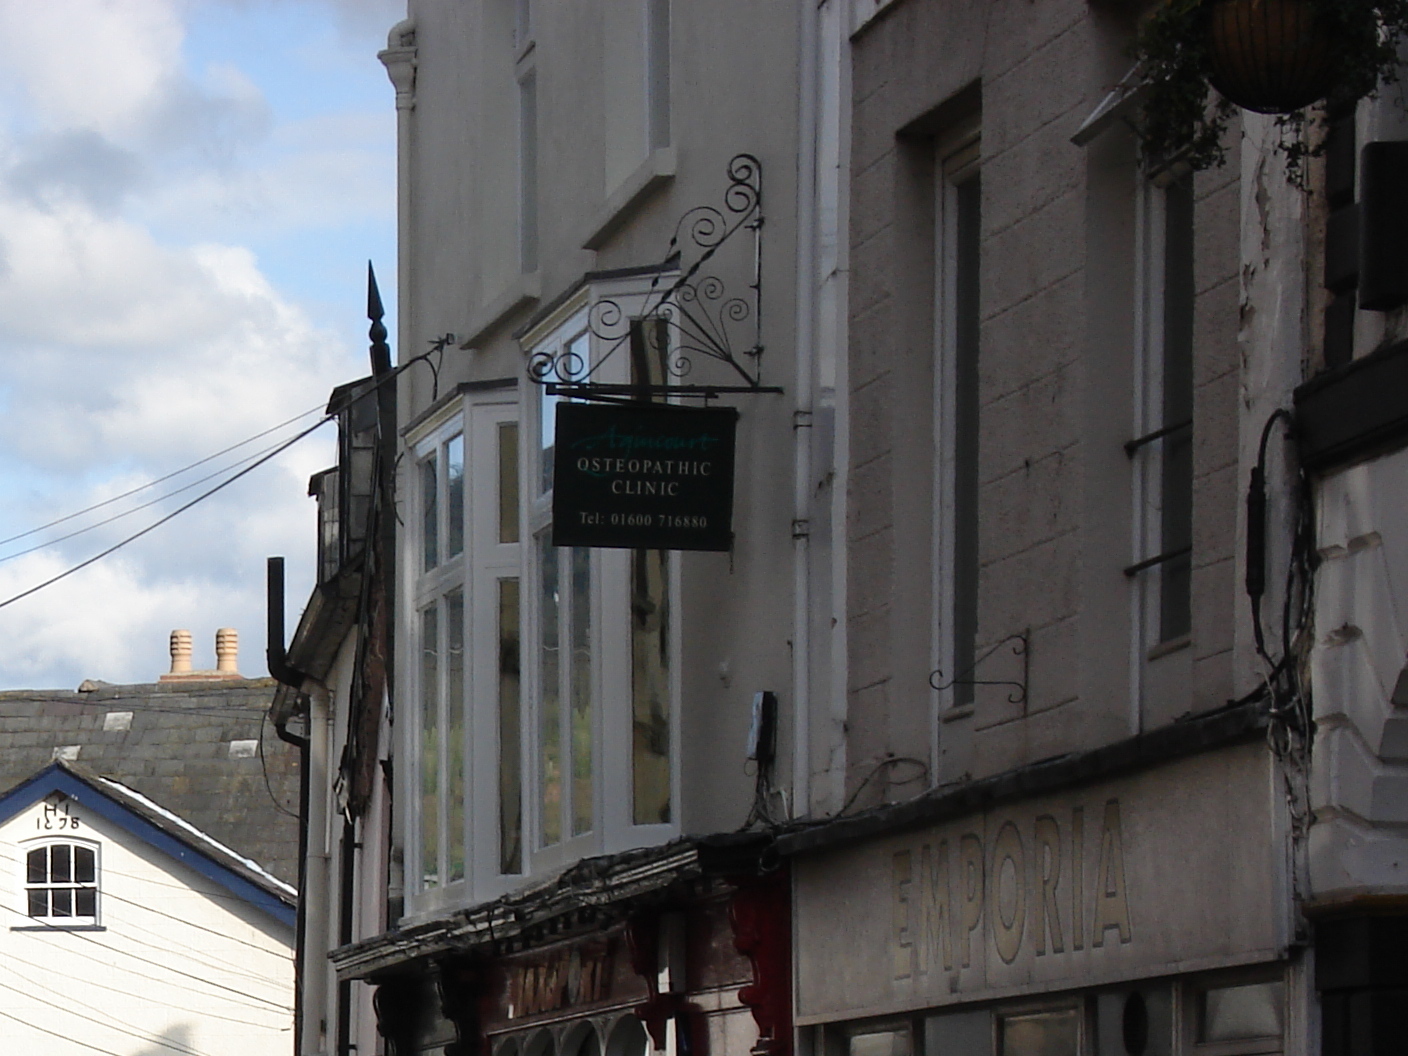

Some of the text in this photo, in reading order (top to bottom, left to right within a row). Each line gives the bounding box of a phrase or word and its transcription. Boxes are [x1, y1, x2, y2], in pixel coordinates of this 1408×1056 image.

[577, 457, 711, 476] OSTEOPATHIC
[611, 480, 679, 496] CLINIC
[579, 512, 707, 528] Tel: 01600 716880
[892, 798, 1132, 981] EMPORIA
